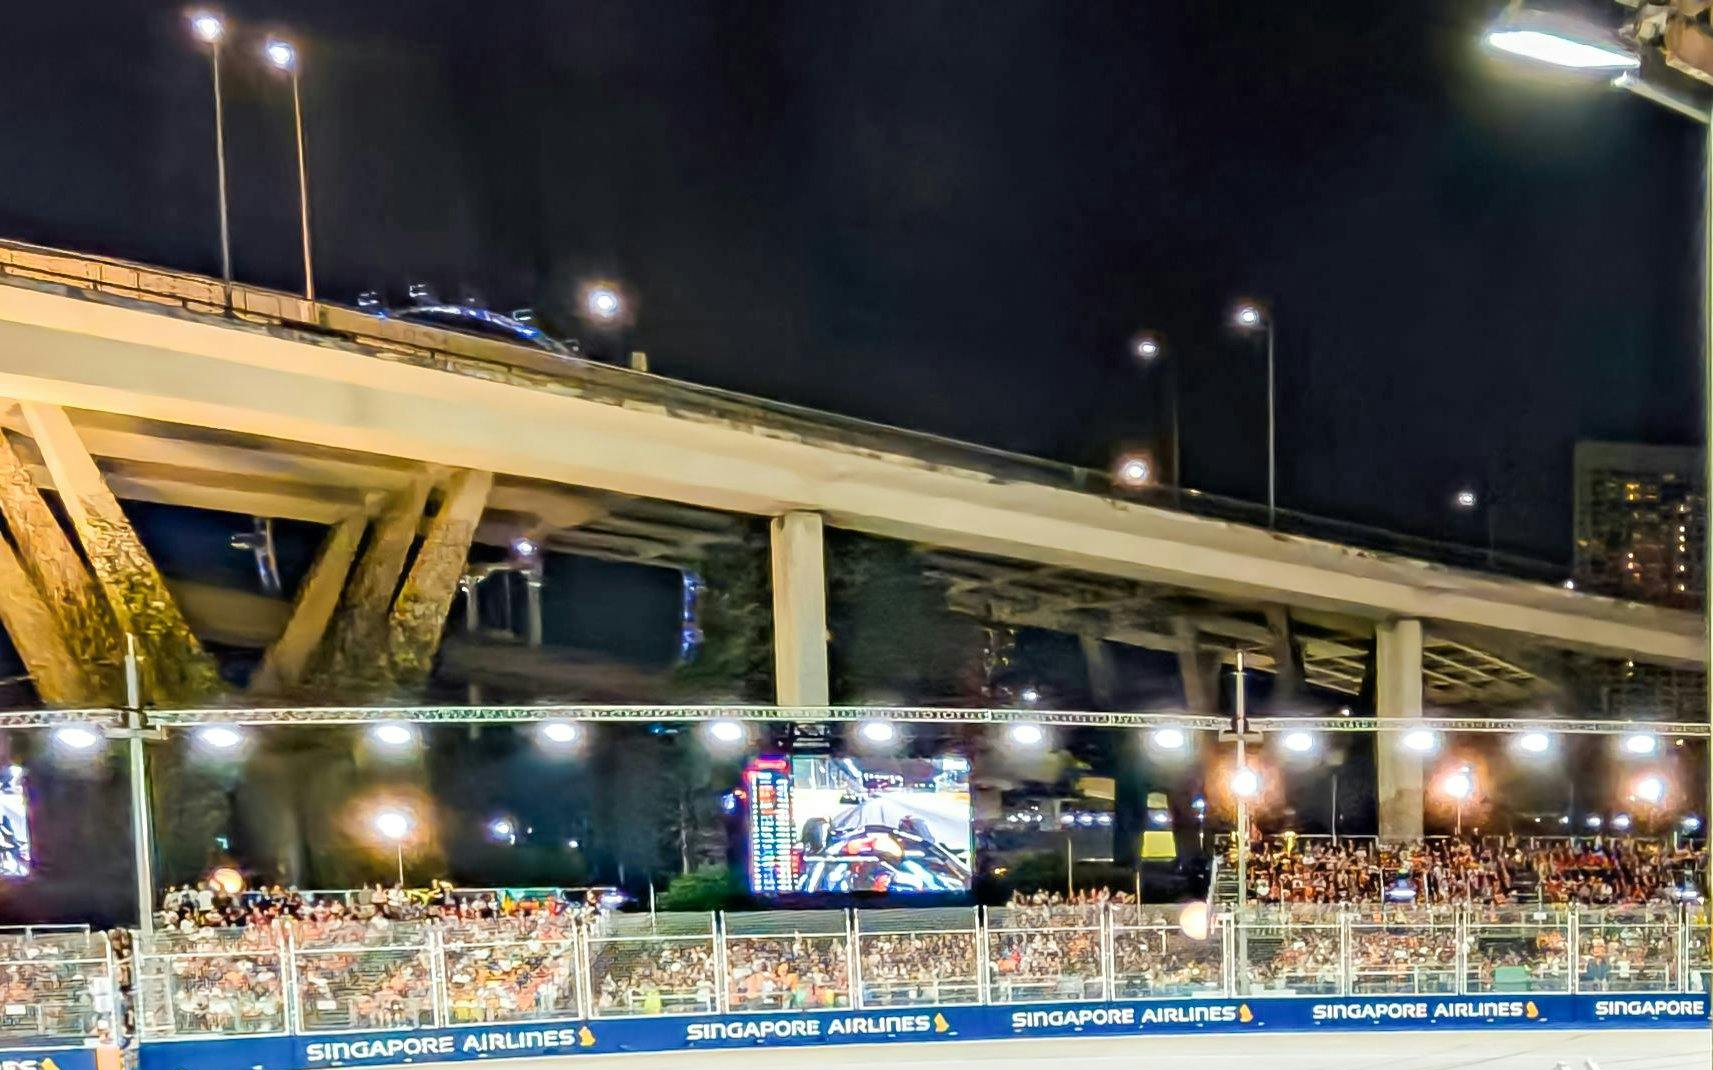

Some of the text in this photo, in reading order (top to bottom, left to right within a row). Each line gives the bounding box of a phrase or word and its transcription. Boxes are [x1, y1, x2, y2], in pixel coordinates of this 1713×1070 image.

[1012, 1005, 1236, 1028] SINGAPORE AIRLINES
[1312, 1001, 1523, 1019] SINGAPORE AIRLINES
[1595, 1001, 1704, 1017] SINGAPORE
[686, 1014, 931, 1040] SINGAPORE AIRLINES
[306, 1027, 576, 1061] SINGAPORE AIRLINES
